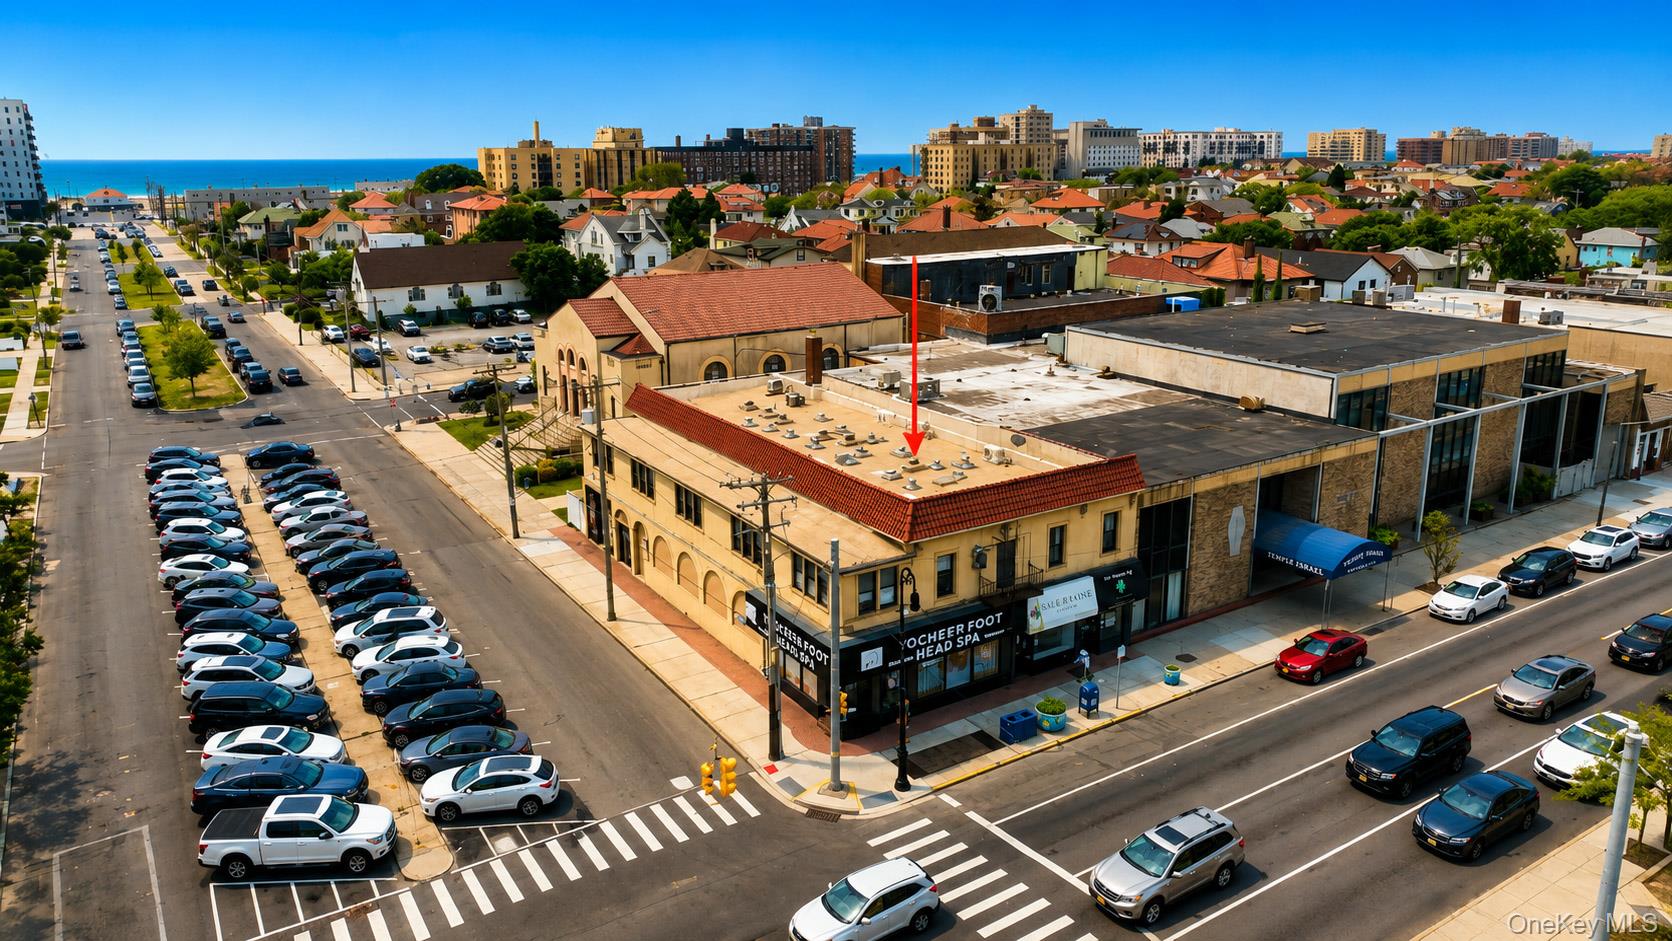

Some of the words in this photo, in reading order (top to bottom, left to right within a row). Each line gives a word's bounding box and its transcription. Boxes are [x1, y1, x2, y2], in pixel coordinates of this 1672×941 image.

[967, 612, 1003, 632] FOOT
[803, 640, 829, 666] FOOT
[916, 640, 953, 661] HEAD
[956, 632, 980, 648] SPA
